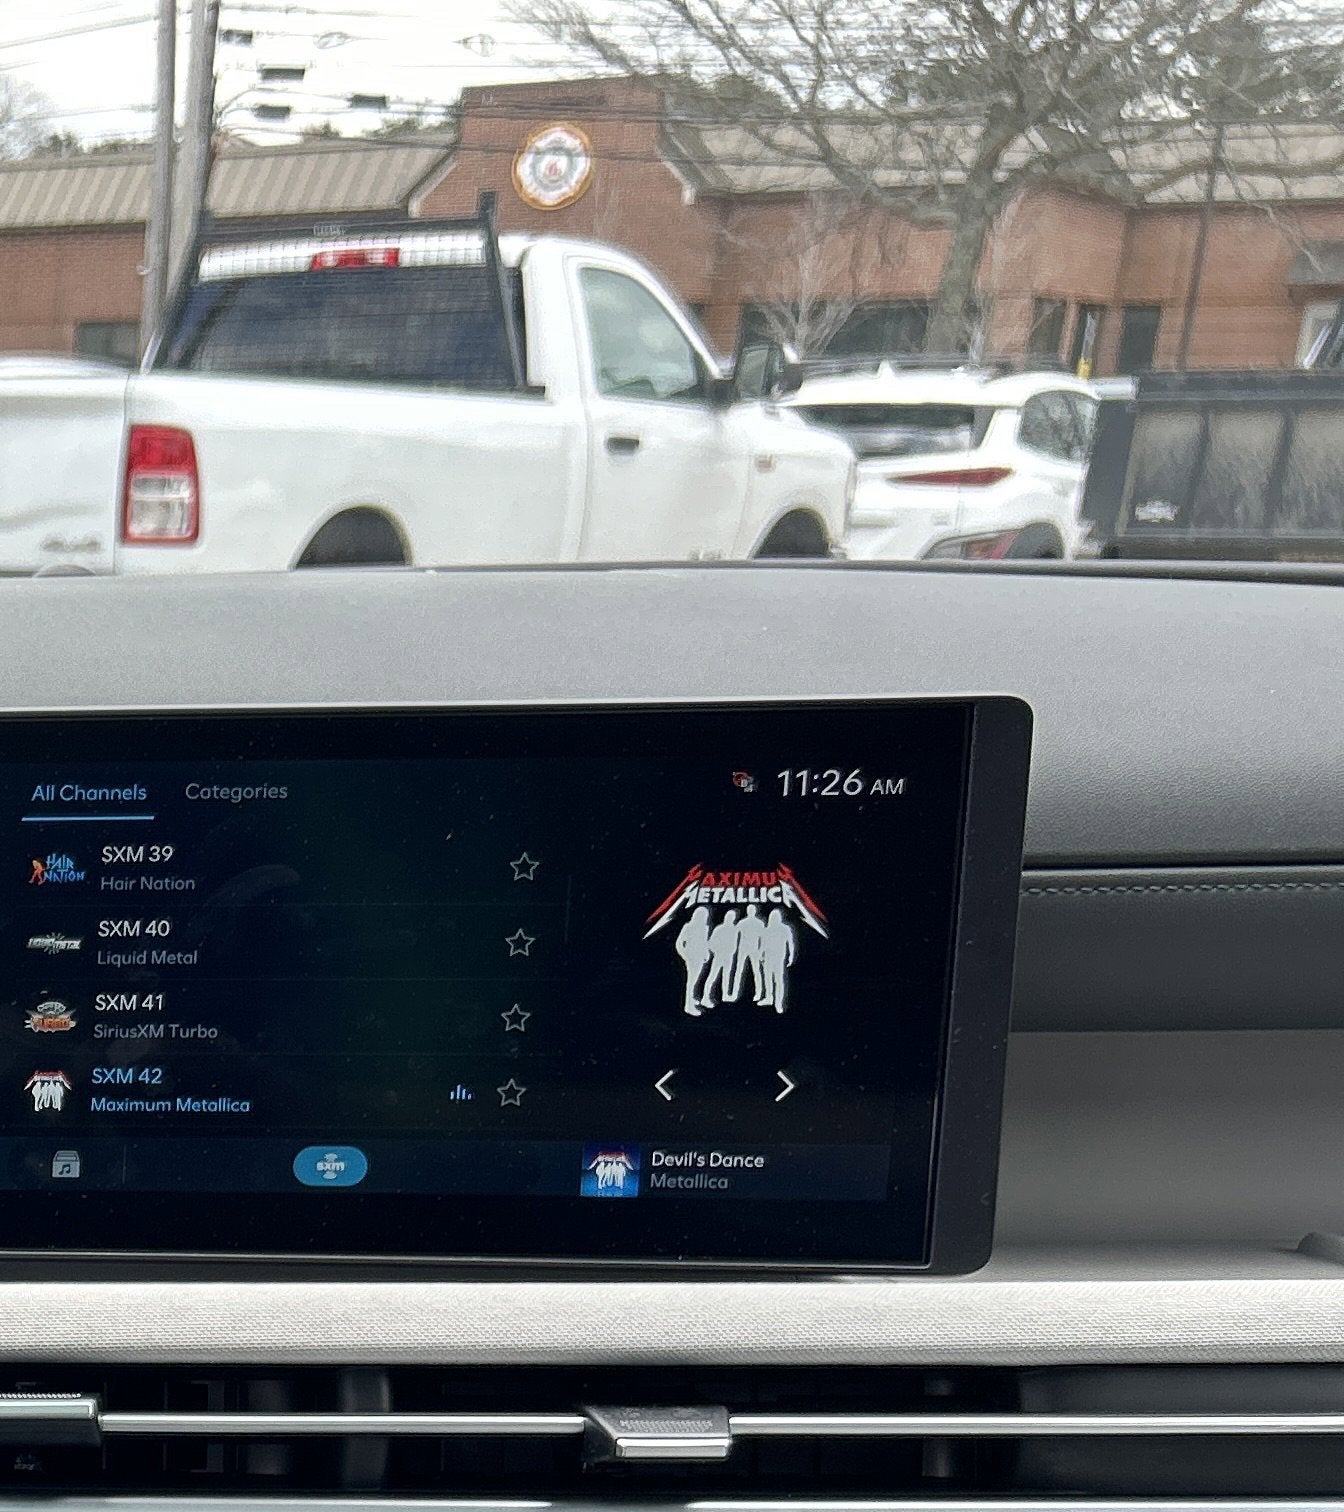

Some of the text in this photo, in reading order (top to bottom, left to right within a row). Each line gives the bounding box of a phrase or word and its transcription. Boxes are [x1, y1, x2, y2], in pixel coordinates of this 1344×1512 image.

[777, 768, 905, 796] 11:26 AM
[32, 784, 148, 801] All Channels
[185, 783, 288, 803] Categories
[101, 845, 174, 863] SXM 39
[100, 876, 195, 891] Hair Nation
[97, 920, 170, 937] SXM 40
[97, 950, 198, 968] Liquid Metal
[94, 994, 164, 1011] SXM 41
[93, 1024, 218, 1039] SiriusXM Turbo
[91, 1068, 163, 1084] SXM 42
[90, 1097, 251, 1112] Maximum Metallica
[651, 1151, 765, 1168] Devil's Dance
[650, 1173, 729, 1189] Metallica
